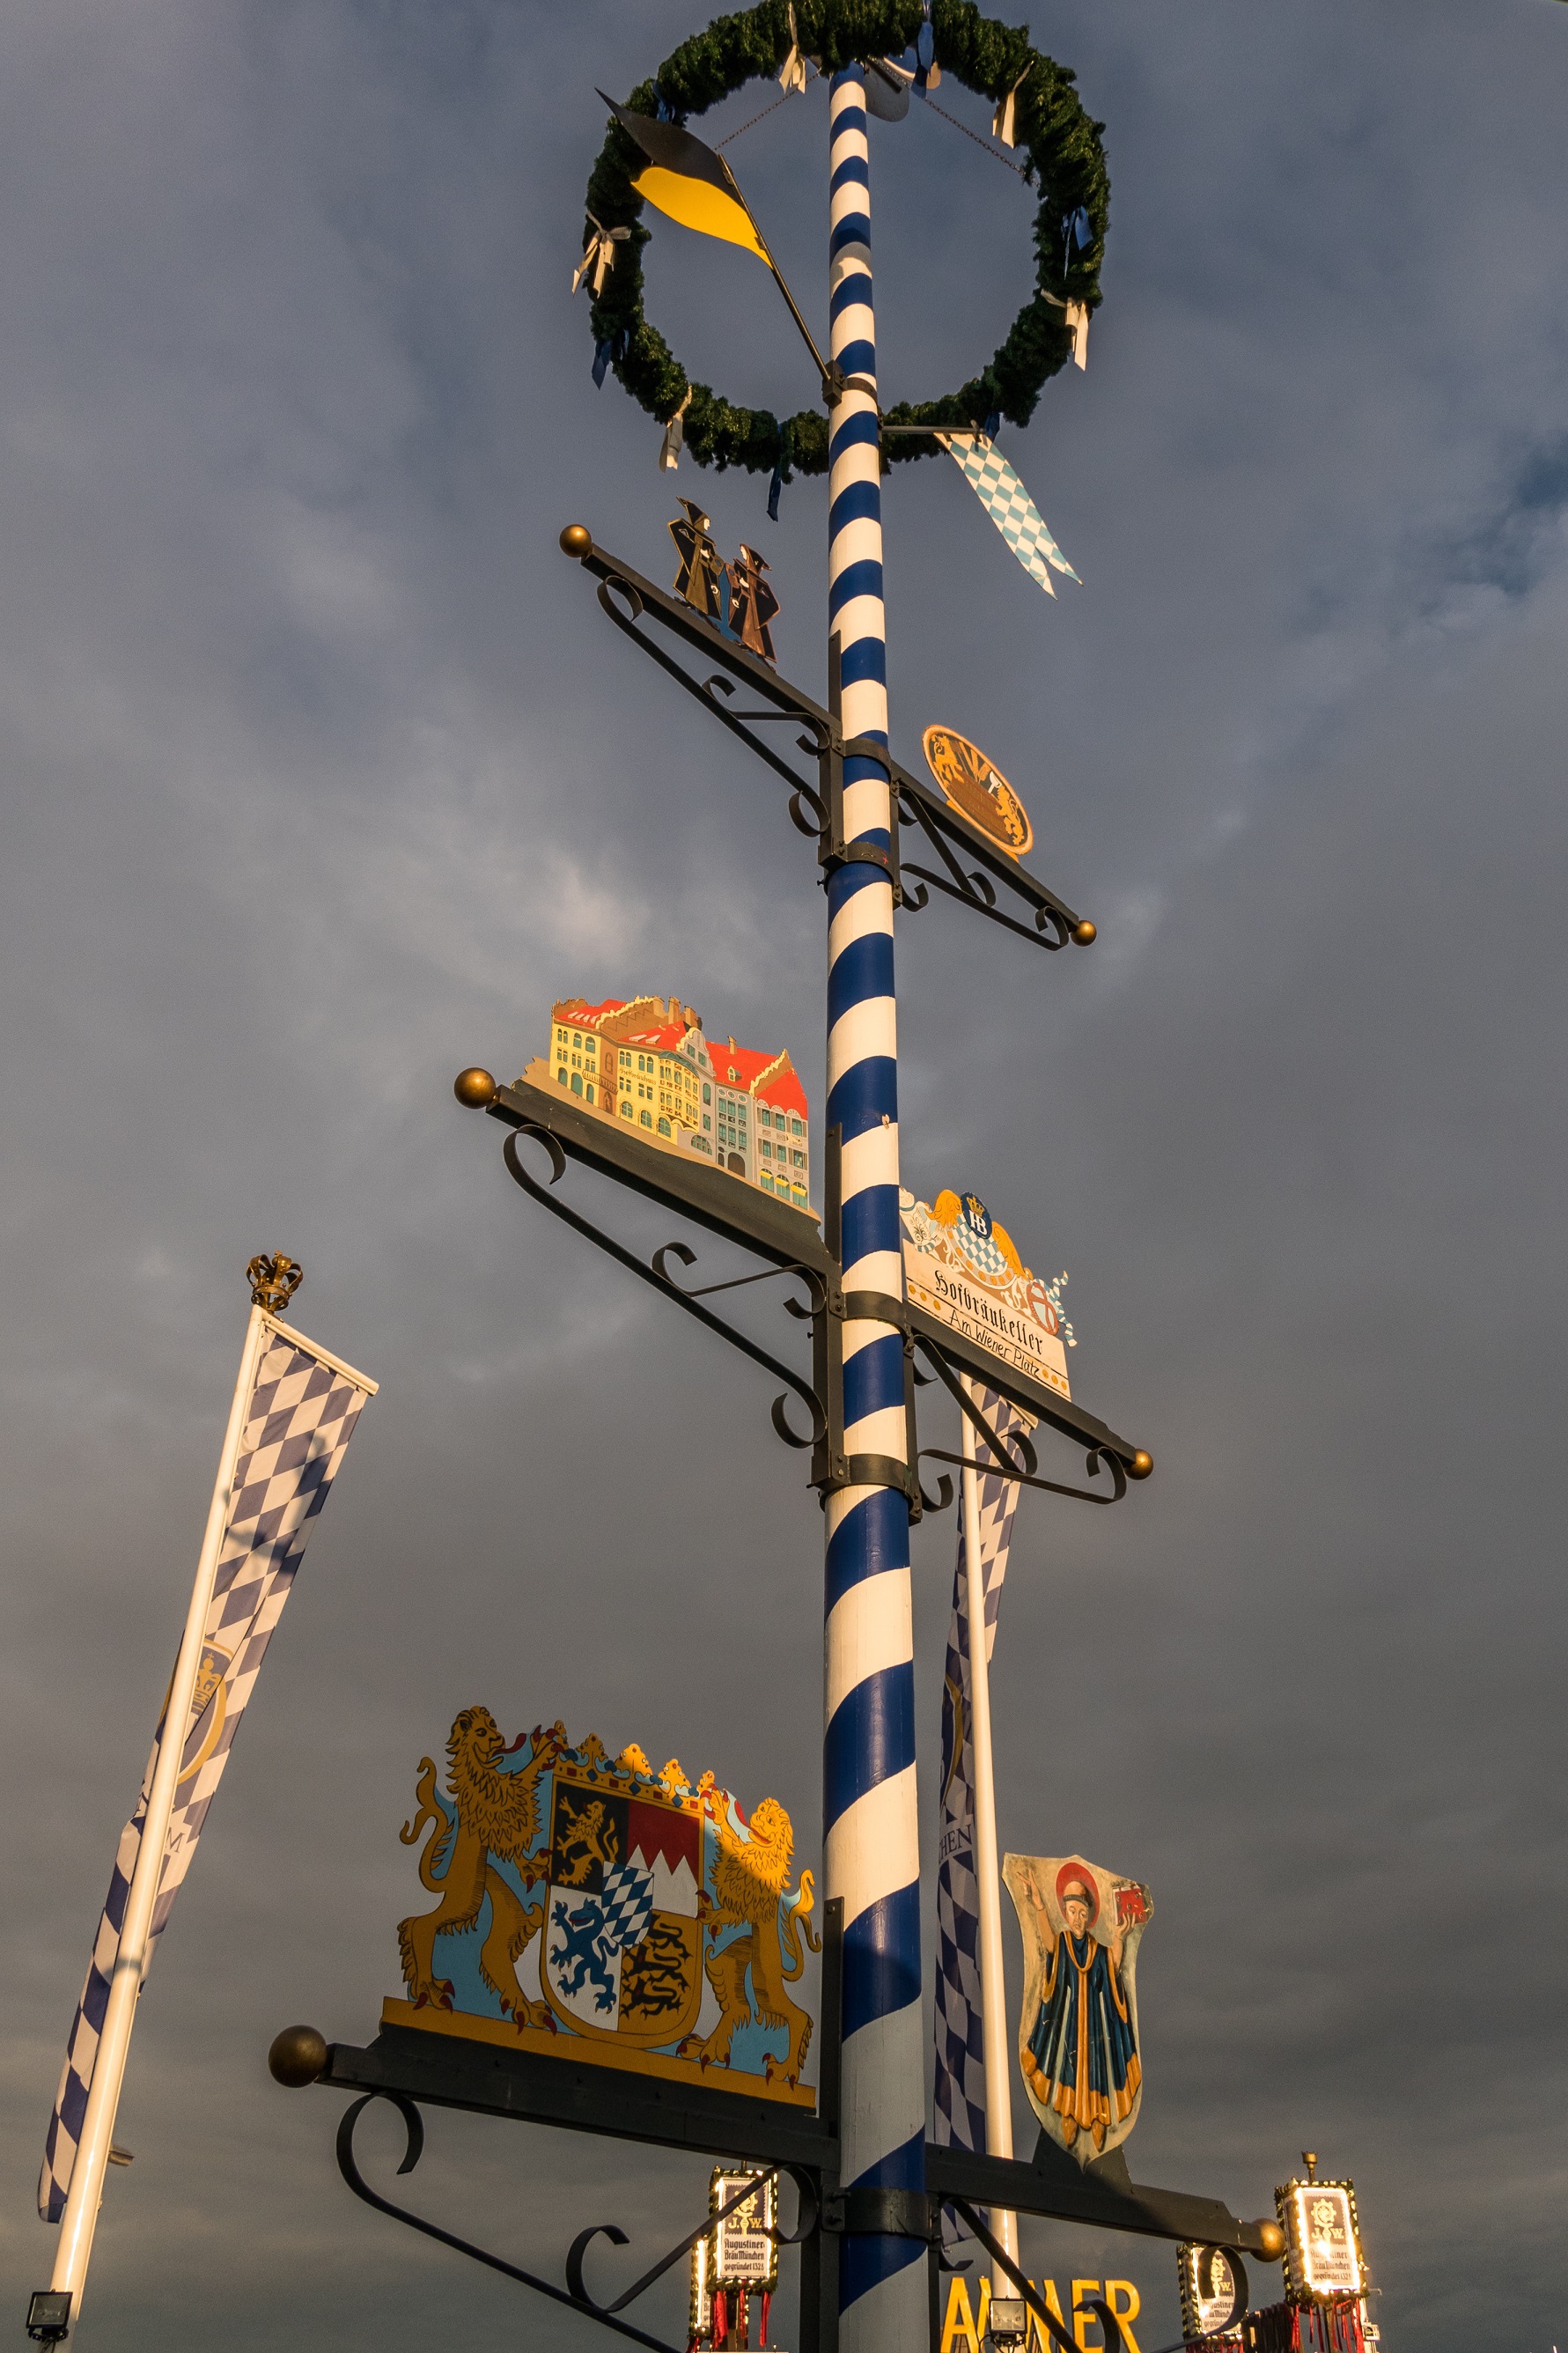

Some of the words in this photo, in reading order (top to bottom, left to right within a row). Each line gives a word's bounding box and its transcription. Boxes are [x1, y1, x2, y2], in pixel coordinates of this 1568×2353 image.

[968, 1209, 988, 1236] HB
[935, 1270, 1043, 1356] Hofbräukeller
[949, 1309, 972, 1337] Am
[975, 1324, 1012, 1358] Wiener
[1013, 1347, 1040, 1379] Platz
